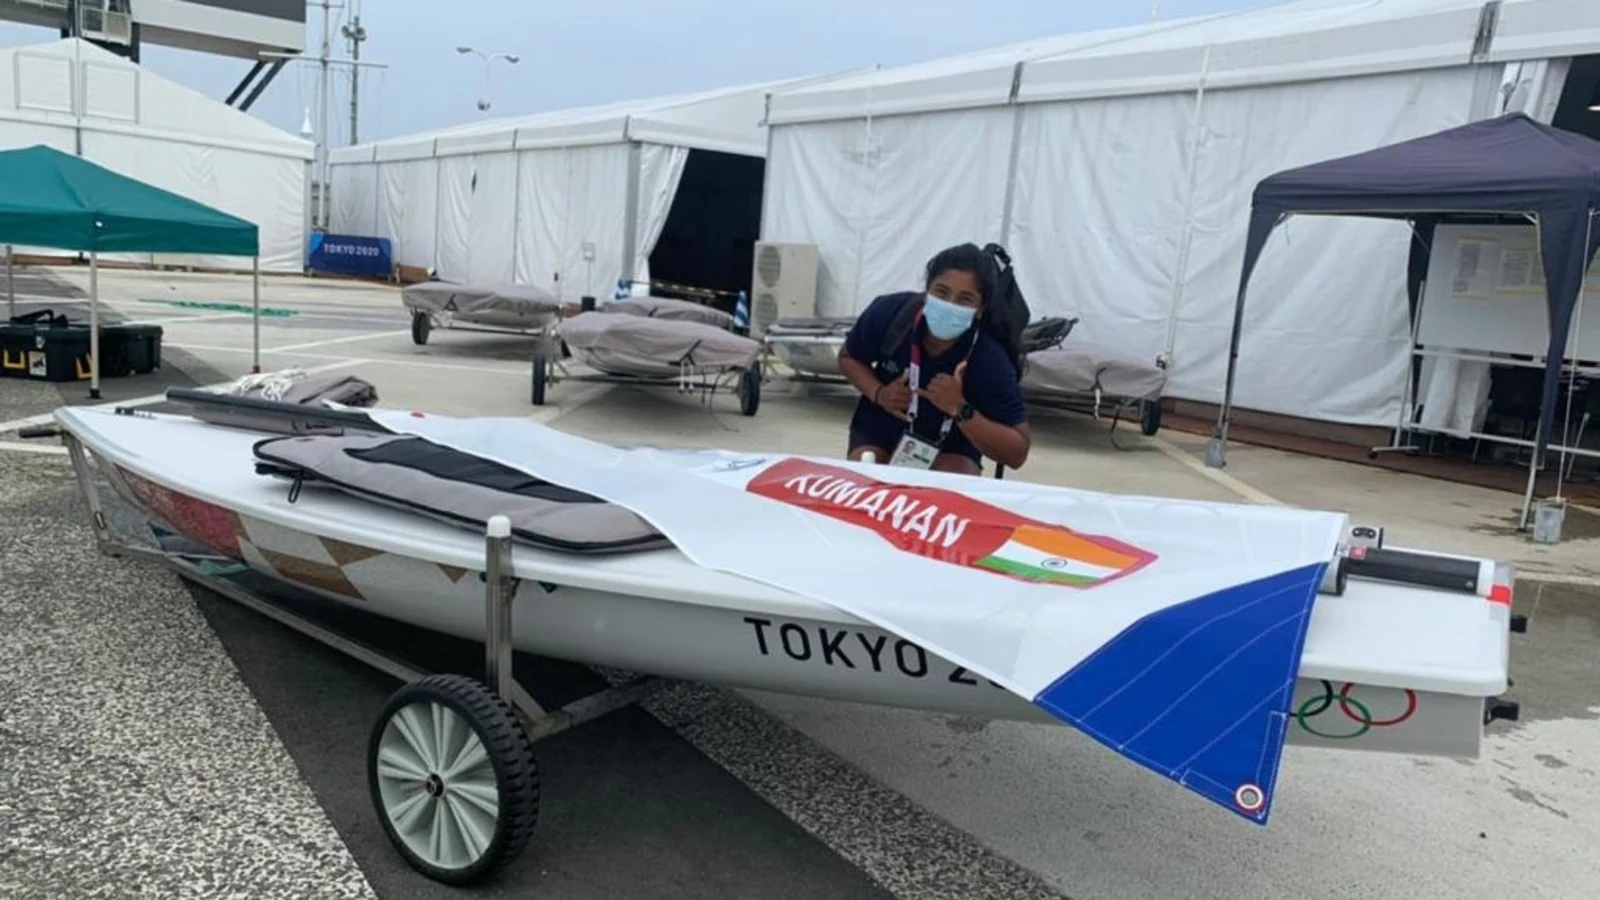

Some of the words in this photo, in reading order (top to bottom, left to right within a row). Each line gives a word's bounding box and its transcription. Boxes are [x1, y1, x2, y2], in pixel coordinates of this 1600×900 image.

[324, 244, 355, 255] TOKYO
[356, 246, 380, 257] 2020
[743, 616, 928, 678] TOKYO
